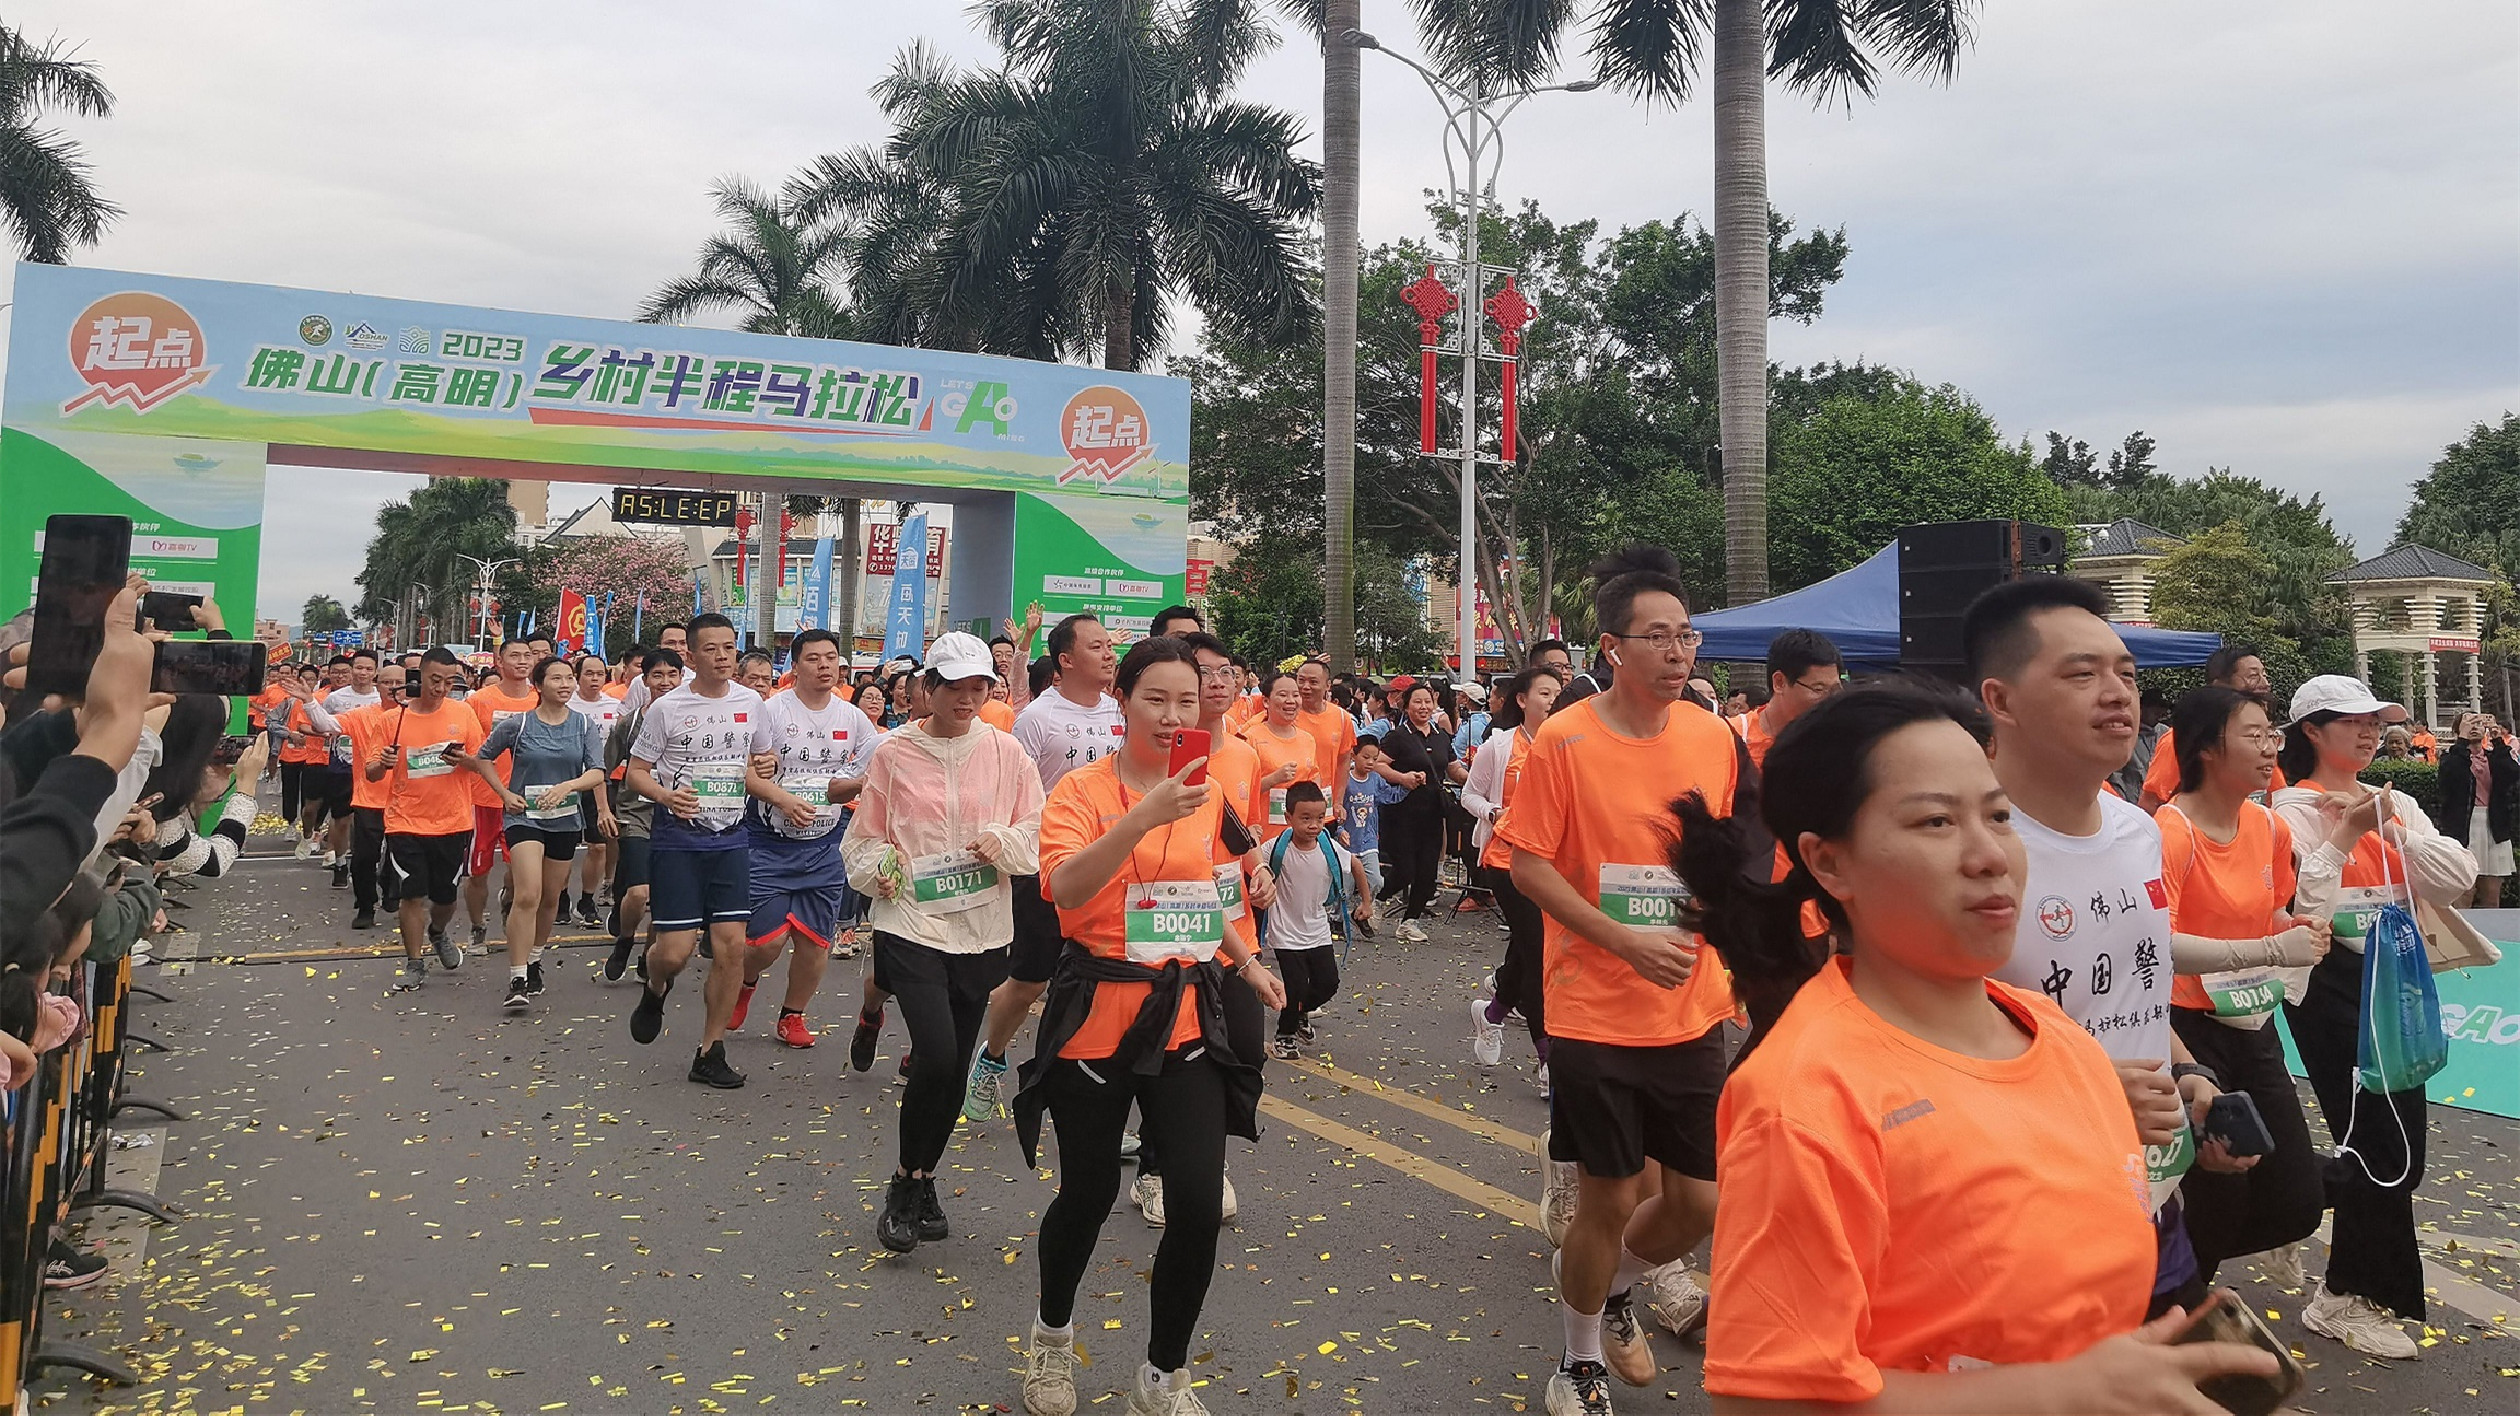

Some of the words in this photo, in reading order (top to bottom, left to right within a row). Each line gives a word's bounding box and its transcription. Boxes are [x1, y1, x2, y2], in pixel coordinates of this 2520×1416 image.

[81, 316, 193, 371] 起点
[443, 333, 524, 361] 2023
[533, 345, 920, 426] 乡村半程马拉松
[1069, 405, 1142, 449] 起点
[936, 870, 982, 894] B0171
[1153, 913, 1211, 933] B0041
[2090, 888, 2137, 923] 佛山
